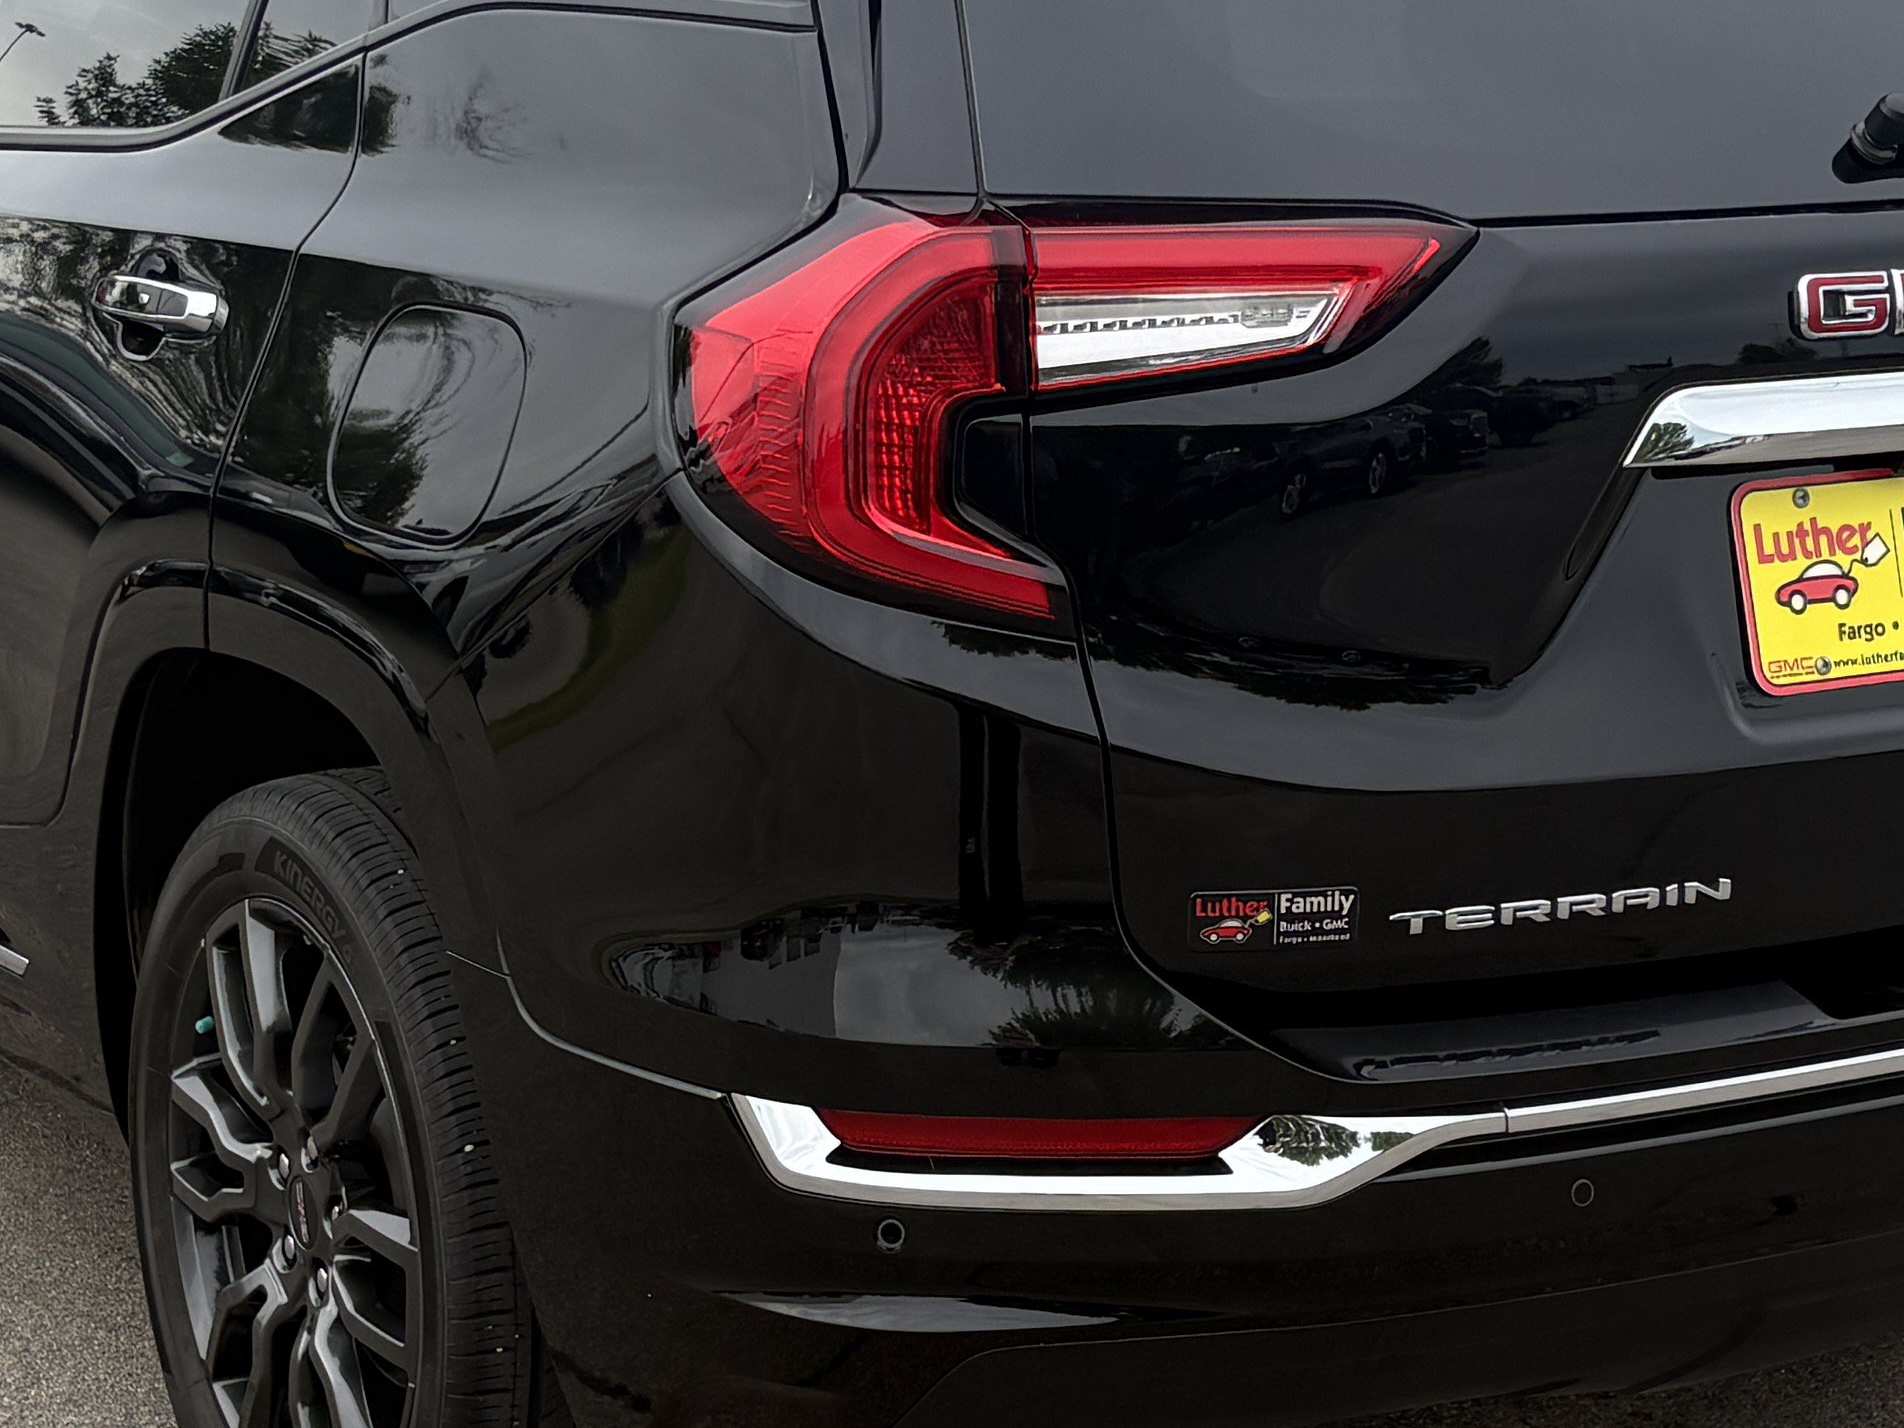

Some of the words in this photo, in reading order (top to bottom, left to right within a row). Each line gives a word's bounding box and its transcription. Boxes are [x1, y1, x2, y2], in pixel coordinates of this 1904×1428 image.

[1753, 517, 1872, 565] Luther
[1838, 622, 1886, 643] Fargo
[1768, 656, 1815, 674] GMC
[274, 850, 346, 939] KINERGY
[1196, 897, 1270, 918] Luther
[1279, 891, 1355, 915] Family
[1389, 878, 1732, 935] TERRAIN
[1279, 920, 1311, 932] Buick
[1322, 918, 1349, 930] GMC
